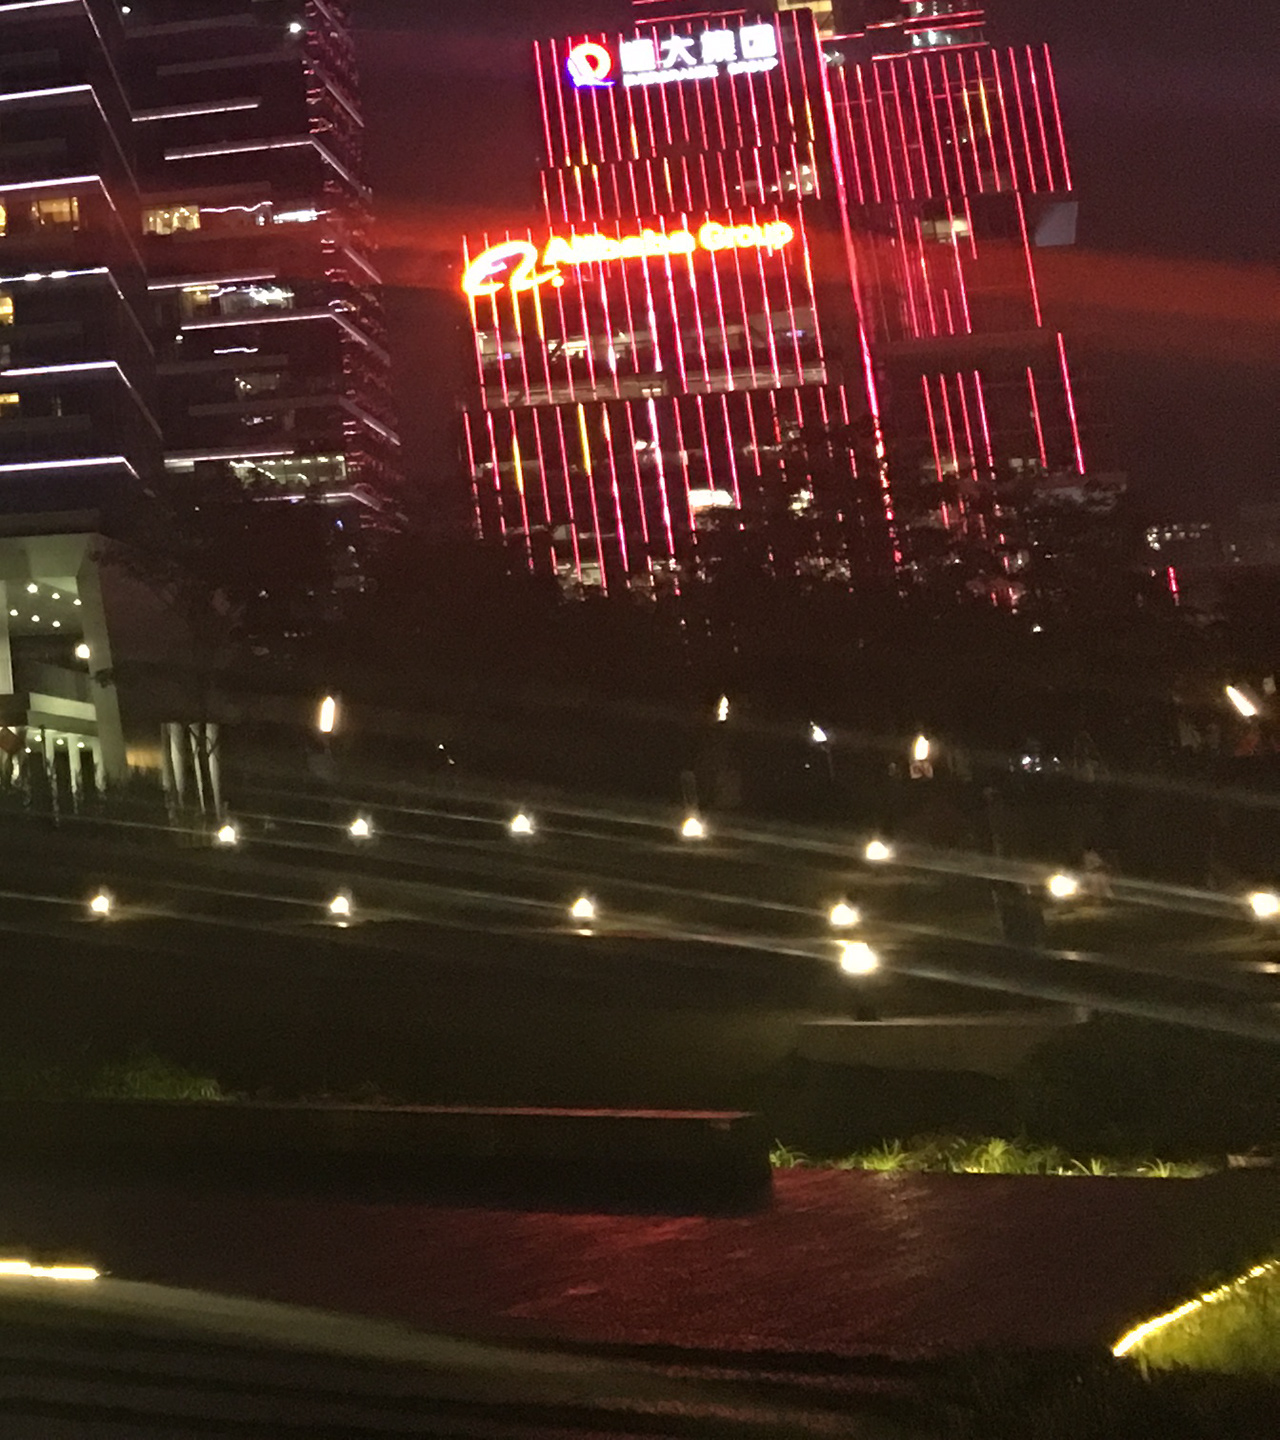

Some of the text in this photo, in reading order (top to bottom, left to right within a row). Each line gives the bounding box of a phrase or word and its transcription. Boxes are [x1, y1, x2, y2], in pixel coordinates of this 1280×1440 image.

[620, 24, 778, 72] 大集团
[699, 220, 793, 257] Group
